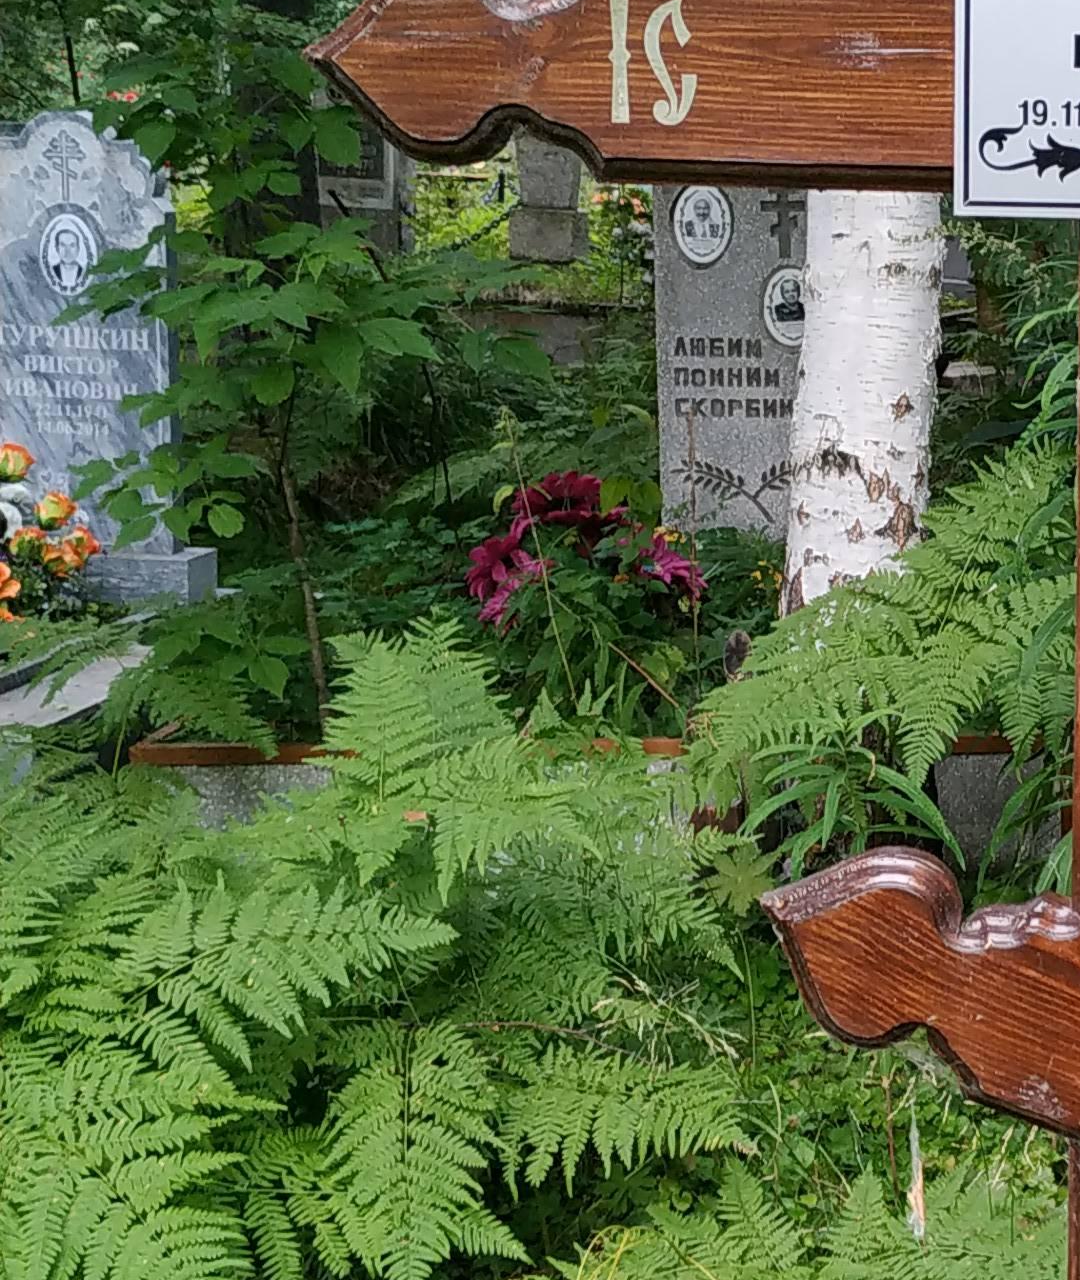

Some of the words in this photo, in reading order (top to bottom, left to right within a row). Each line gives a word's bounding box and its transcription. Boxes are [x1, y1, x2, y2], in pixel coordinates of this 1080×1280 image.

[674, 336, 762, 358] ЛЮБИМ
[24, 354, 120, 375] ВИКТОР
[674, 367, 780, 388] ПОМНИМ
[674, 398, 794, 418] СКОРБИМ
